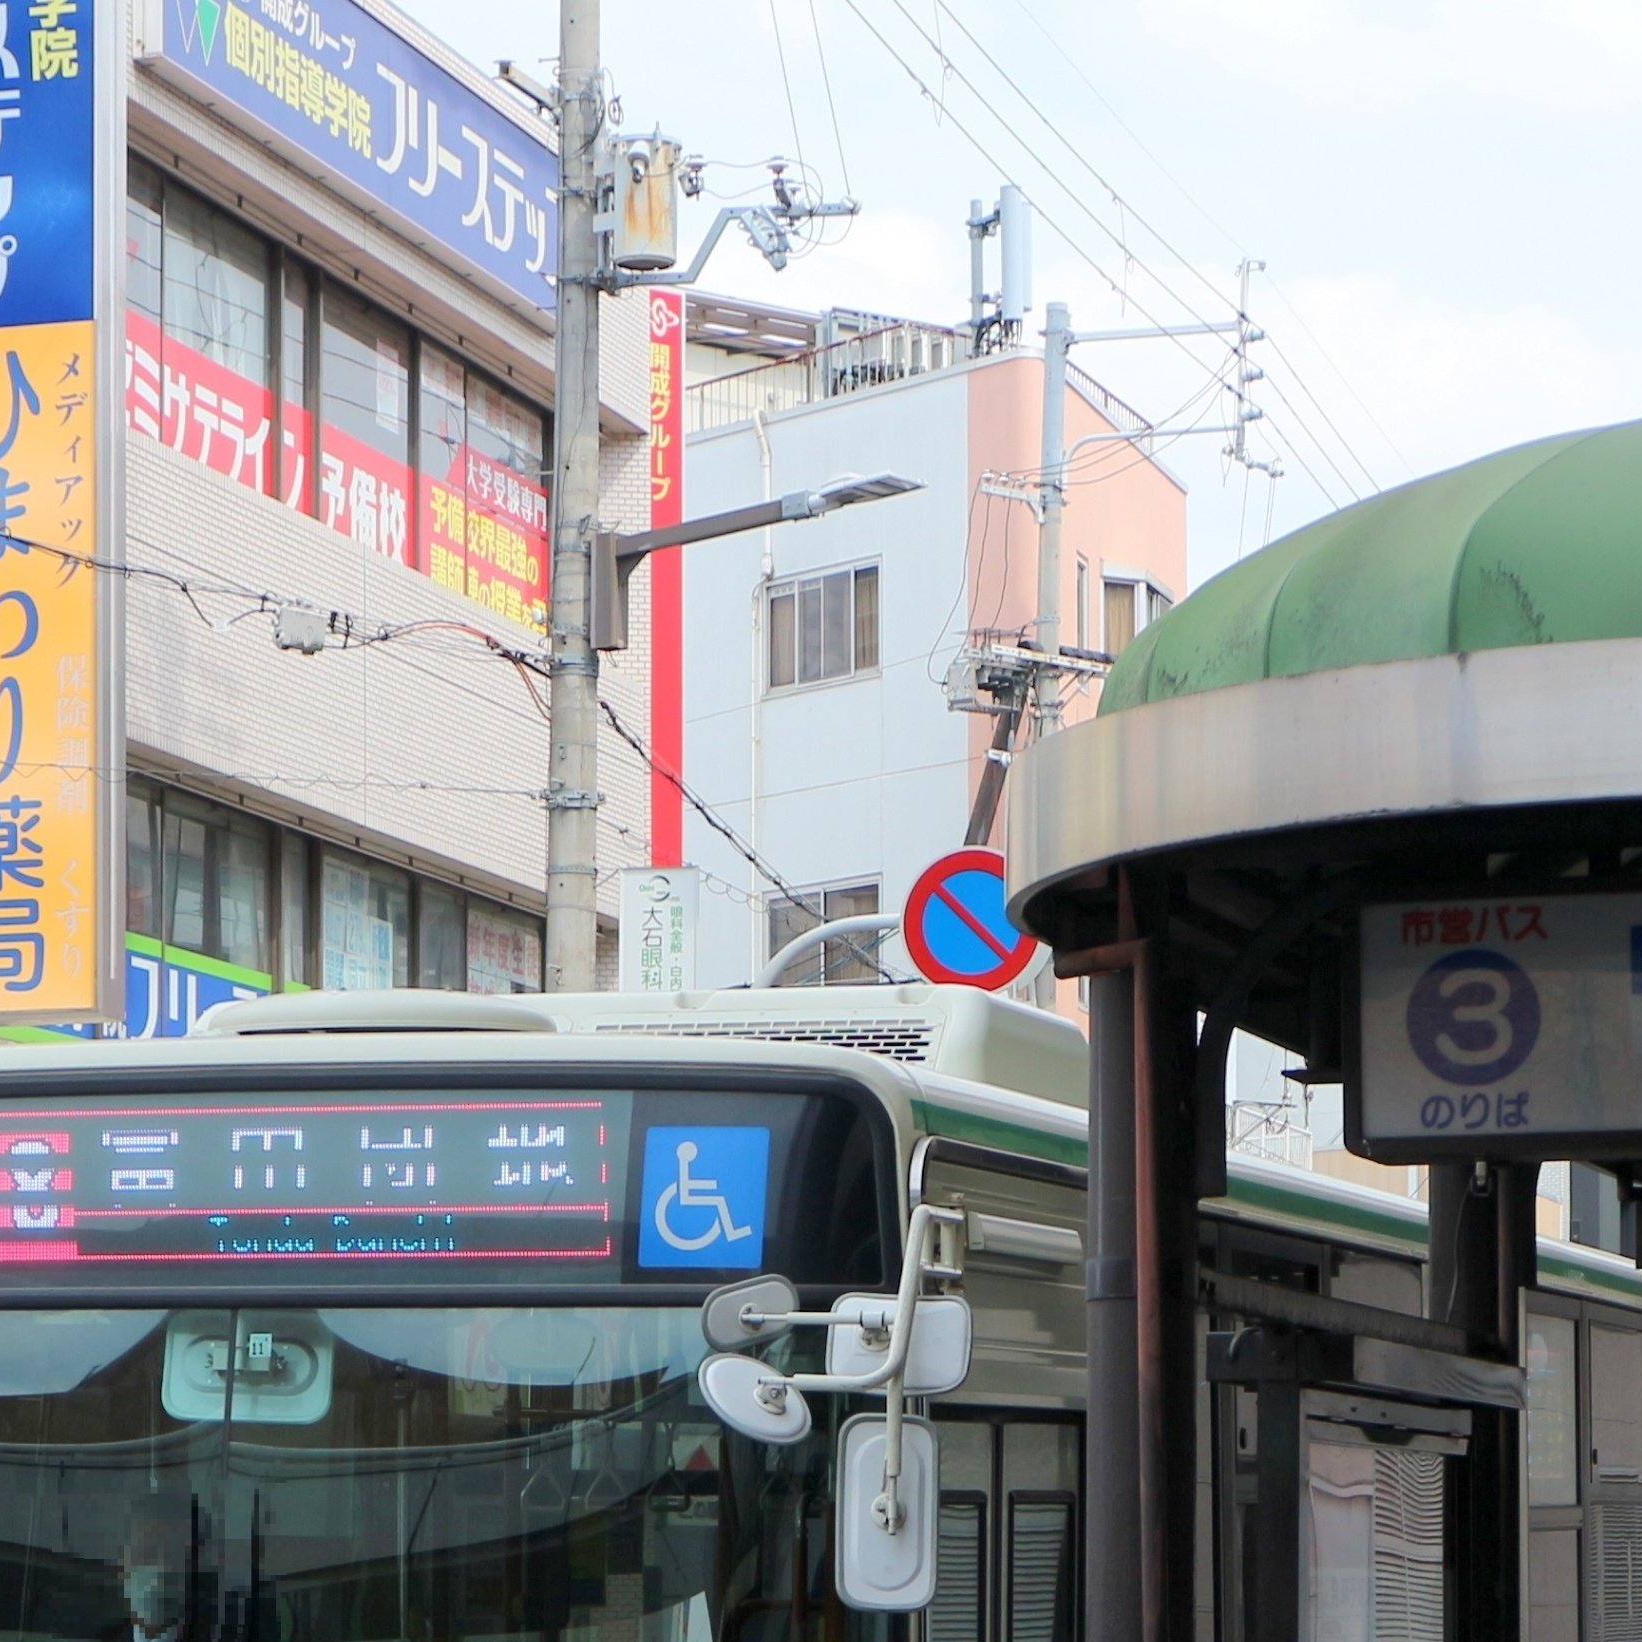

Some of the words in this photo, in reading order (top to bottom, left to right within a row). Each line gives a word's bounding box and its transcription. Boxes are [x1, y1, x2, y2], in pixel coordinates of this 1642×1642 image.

[224, 0, 373, 160] 個別指導学院
[53, 352, 89, 589] メディアック
[650, 341, 671, 501] 開成グループ
[466, 455, 547, 532] 大学受験専門
[56, 655, 90, 815] 保険調剤
[55, 858, 89, 977] くすり
[641, 906, 664, 991] 大石眼科
[1400, 905, 1549, 947] 市営バス
[1420, 1090, 1531, 1130] のりば
